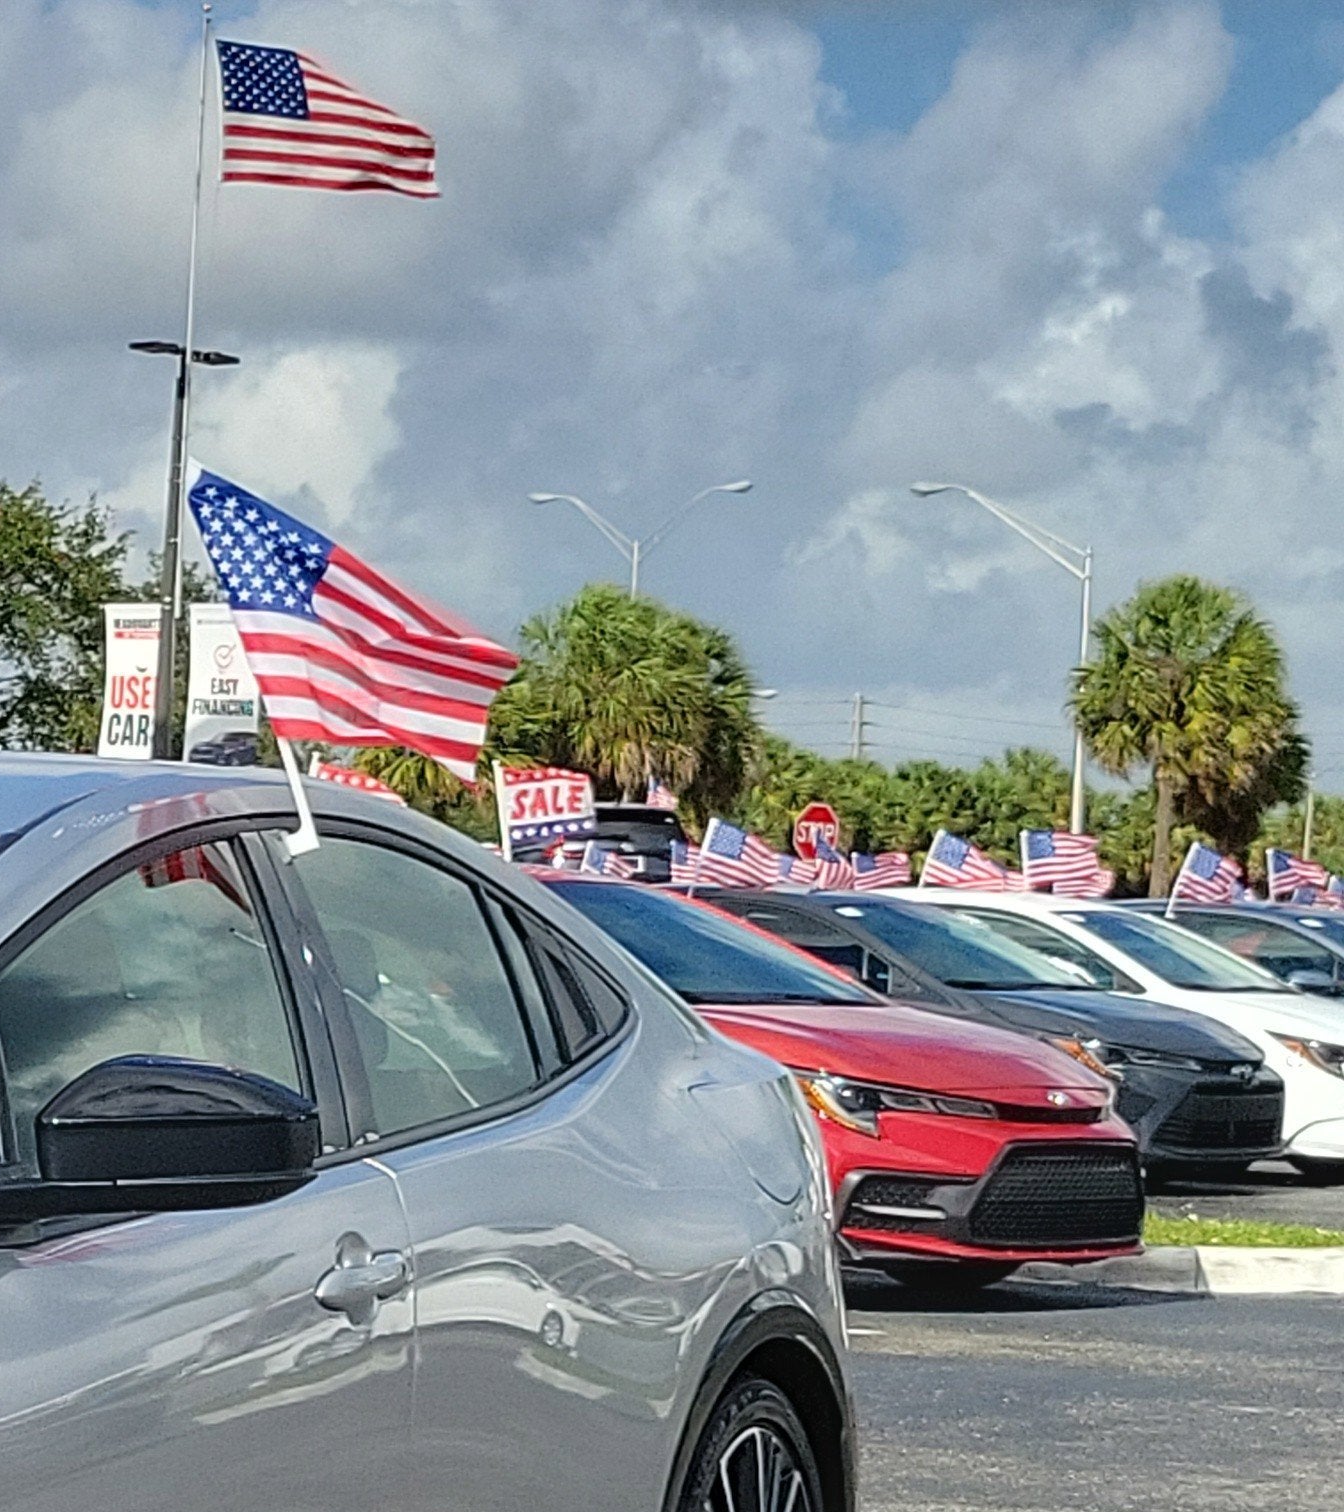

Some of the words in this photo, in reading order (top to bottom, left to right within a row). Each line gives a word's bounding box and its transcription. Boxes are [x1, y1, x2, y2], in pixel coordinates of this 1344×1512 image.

[111, 675, 158, 709] USE
[107, 713, 150, 746] CAR
[511, 785, 584, 819] SALE
